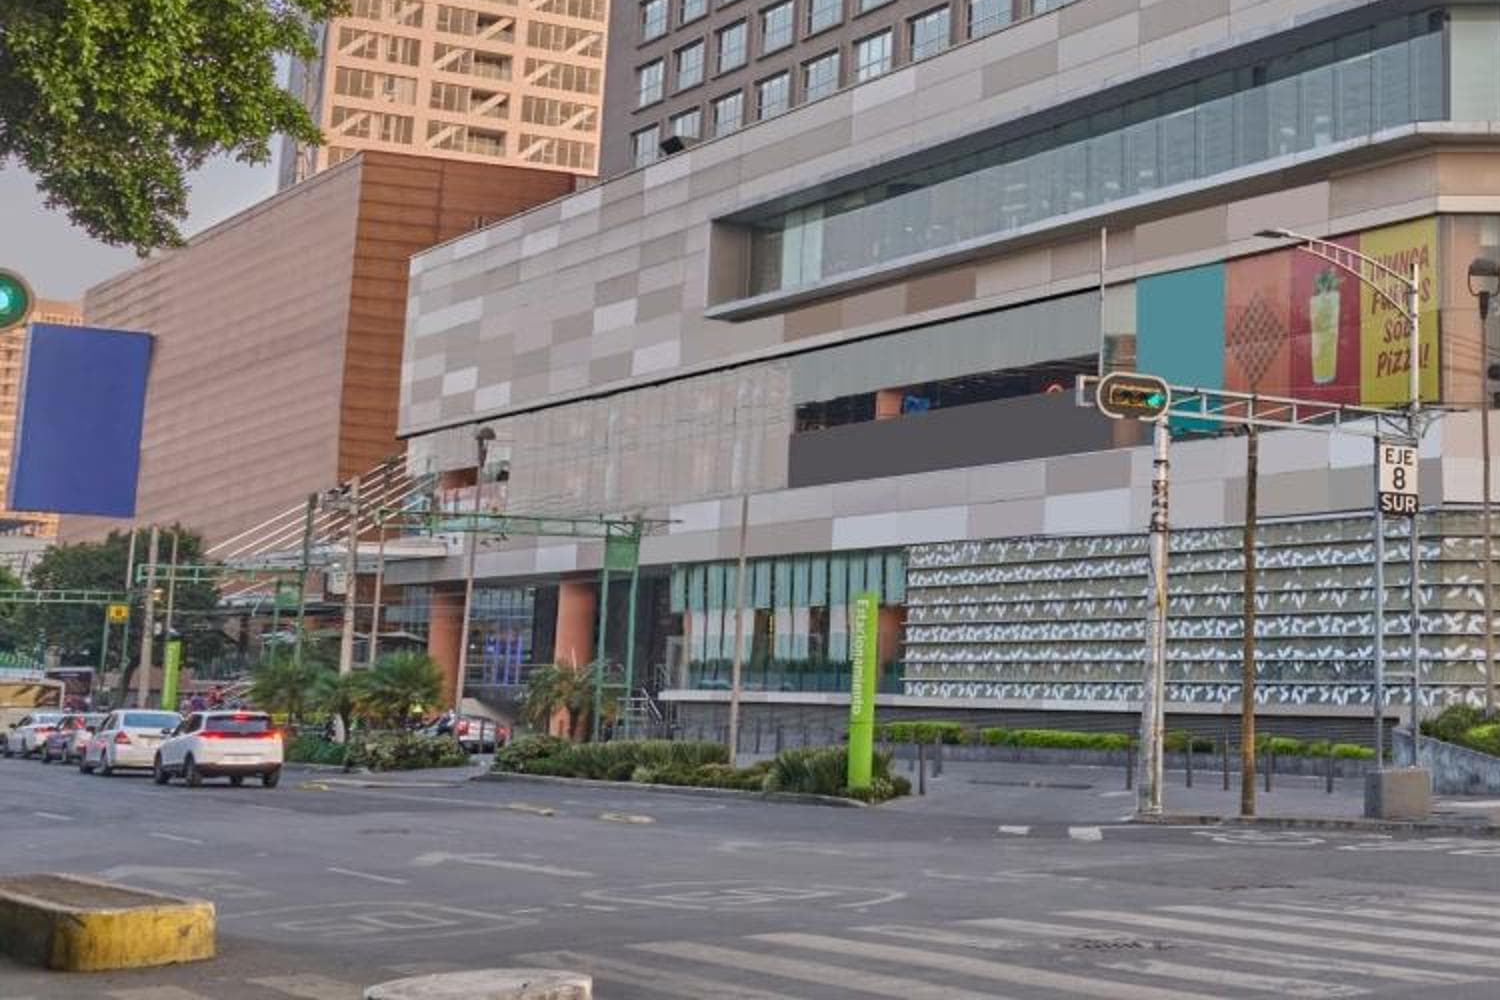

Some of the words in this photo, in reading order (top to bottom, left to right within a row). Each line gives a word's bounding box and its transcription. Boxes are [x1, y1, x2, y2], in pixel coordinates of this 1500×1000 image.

[1385, 447, 1414, 466] EJE
[1393, 466, 1406, 490] 8
[1381, 493, 1416, 513] SUR
